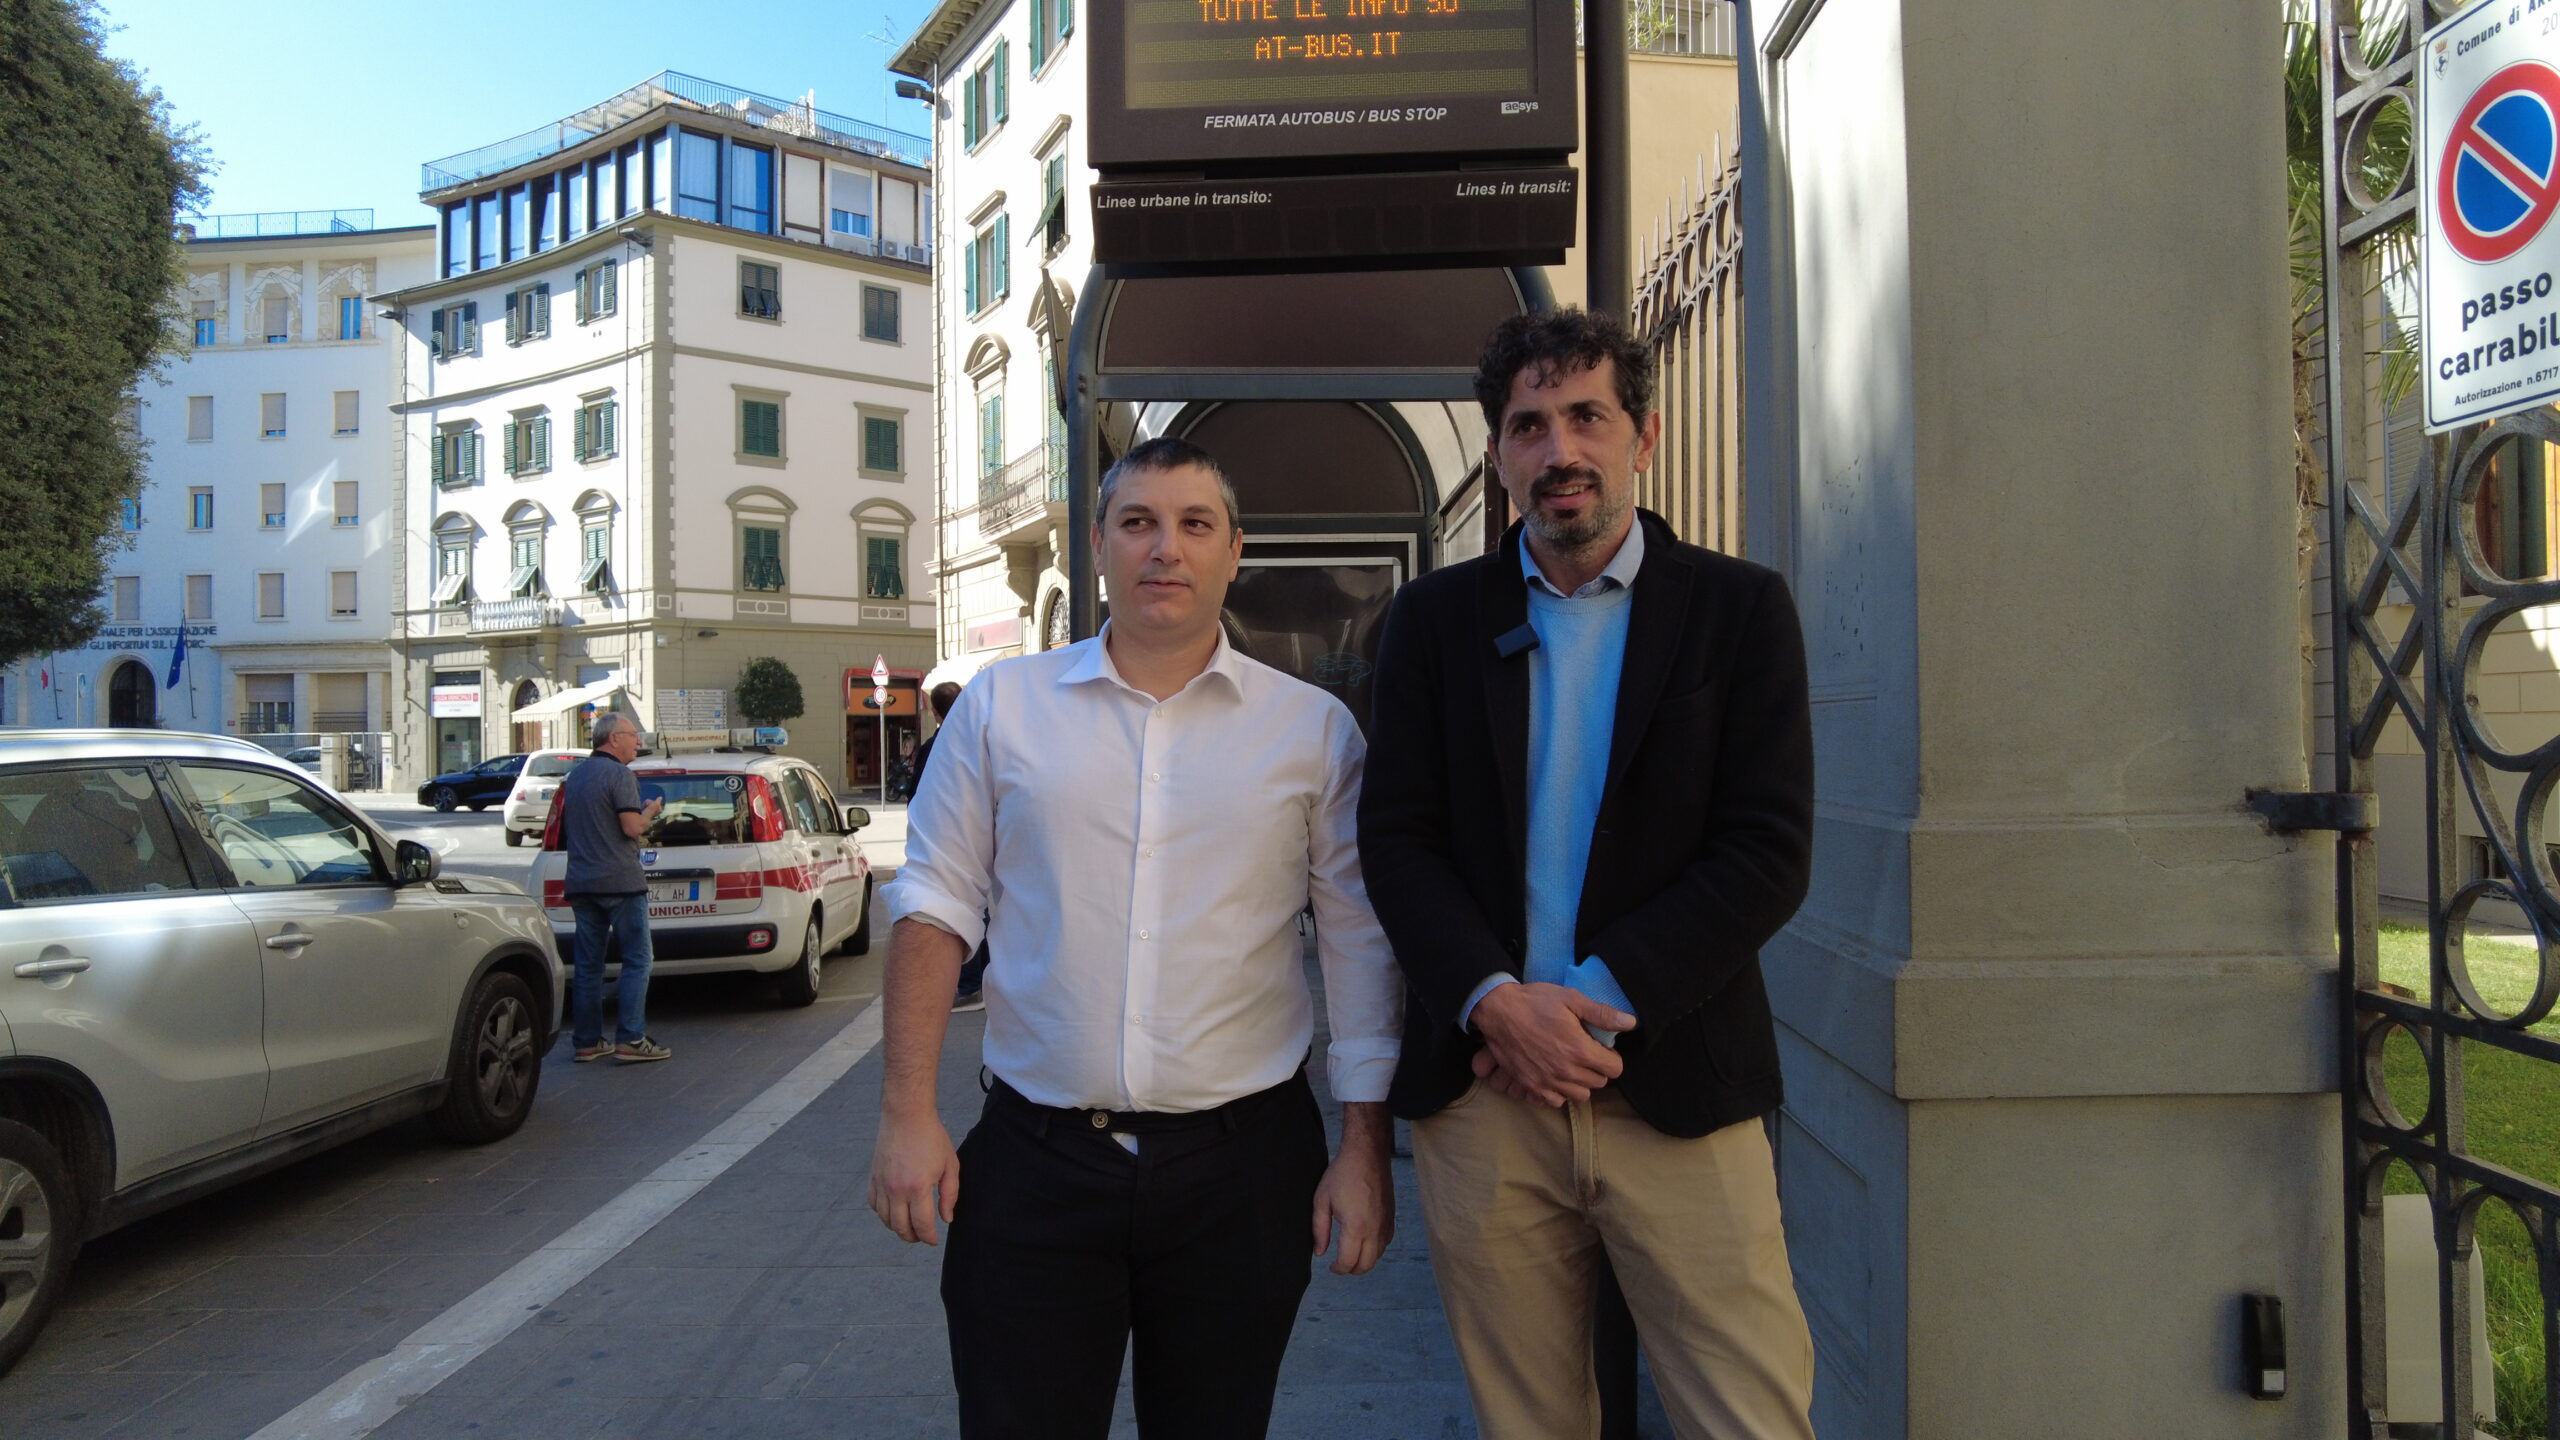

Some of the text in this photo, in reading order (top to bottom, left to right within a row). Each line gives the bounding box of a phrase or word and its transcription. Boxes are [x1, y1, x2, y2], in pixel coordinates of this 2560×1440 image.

[1199, 0, 1278, 21] TUTTE
[1296, 0, 1327, 17] LE
[1347, 0, 1408, 15] INFO
[2457, 21, 2502, 56] Comune
[2508, 5, 2520, 25] di
[1255, 32, 1401, 60] AT-BUS.IT
[1503, 101, 1539, 113] aesys
[1204, 107, 1448, 129] FERMATA AUTOBUS / BUS STOP
[1456, 179, 1572, 196] Lines in transit:
[1097, 190, 1273, 208] Linee urbane in transito:
[2461, 272, 2553, 333] passo
[2440, 312, 2560, 380] carrabil
[2454, 379, 2523, 406] Autorizzazione
[128, 627, 143, 636] PER
[145, 626, 217, 637] L'ASSICUAZIONE
[728, 778, 739, 790] 9
[672, 888, 685, 900] AH
[648, 903, 718, 917] UNICIPALE
